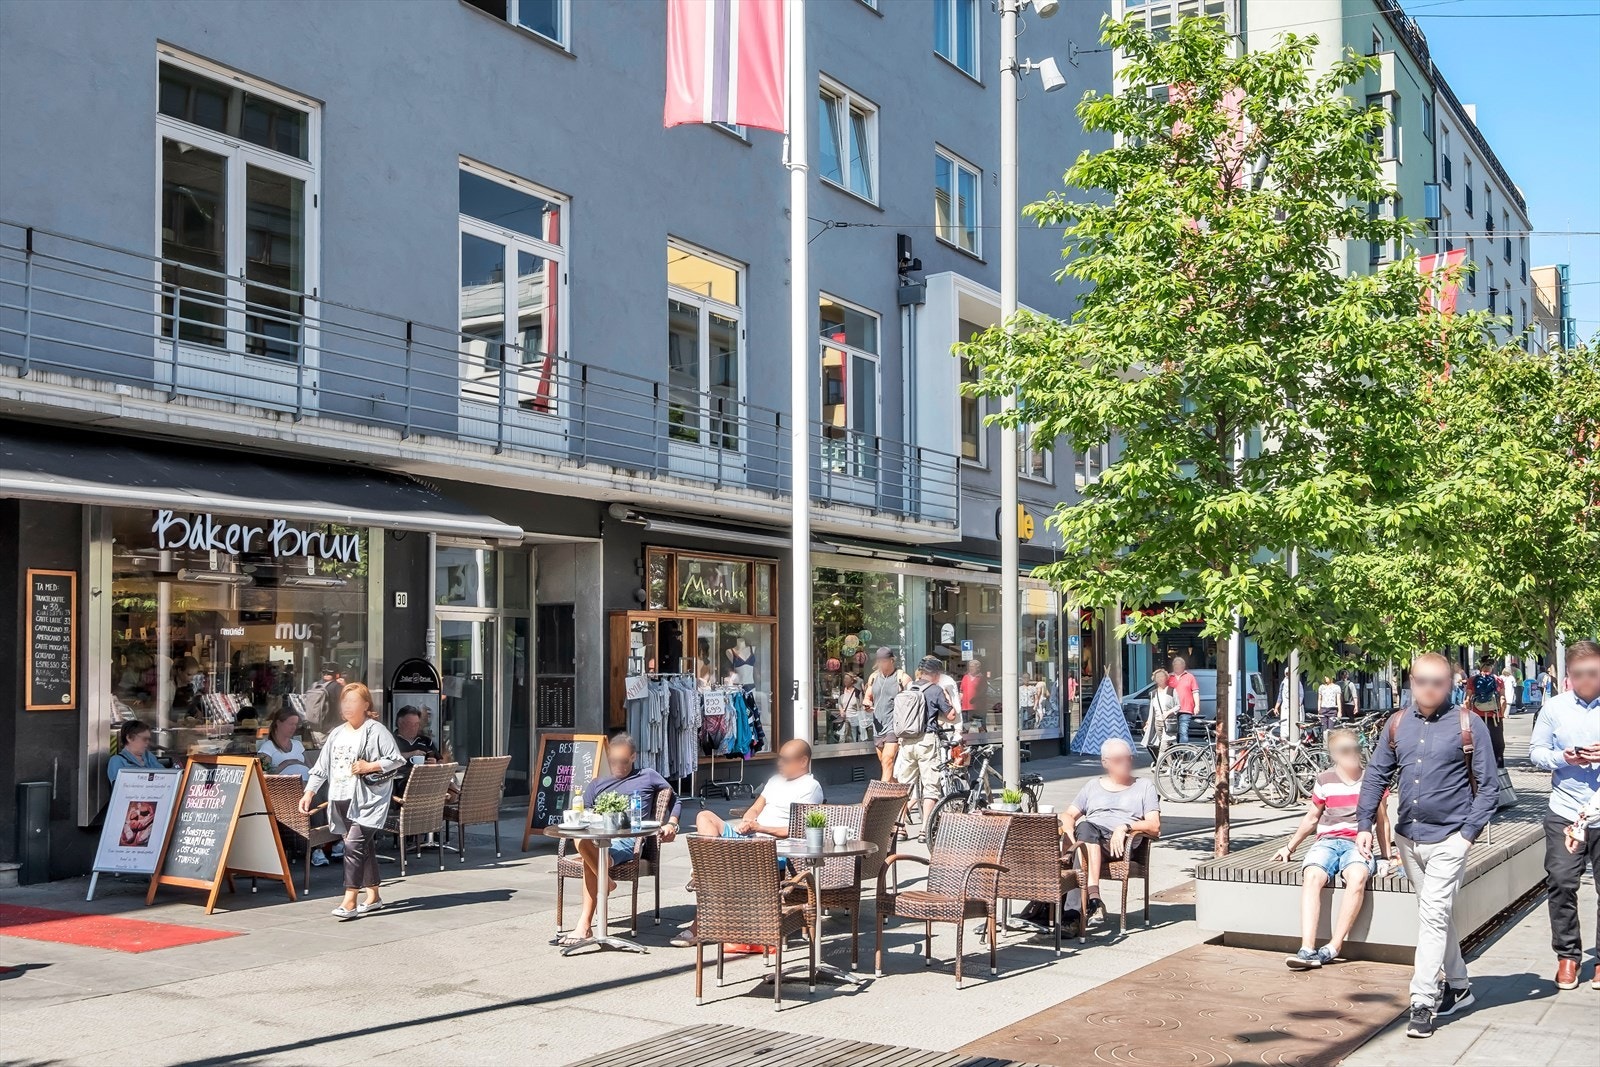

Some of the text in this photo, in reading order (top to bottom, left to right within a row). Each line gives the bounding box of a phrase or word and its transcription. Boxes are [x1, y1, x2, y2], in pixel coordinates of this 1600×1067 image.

[152, 509, 360, 563] Baker Brun
[35, 582, 44, 591] TA
[682, 571, 745, 603] Marinka
[397, 593, 406, 606] 30
[35, 660, 60, 669] ESPRESSO
[559, 743, 580, 754] BESTE
